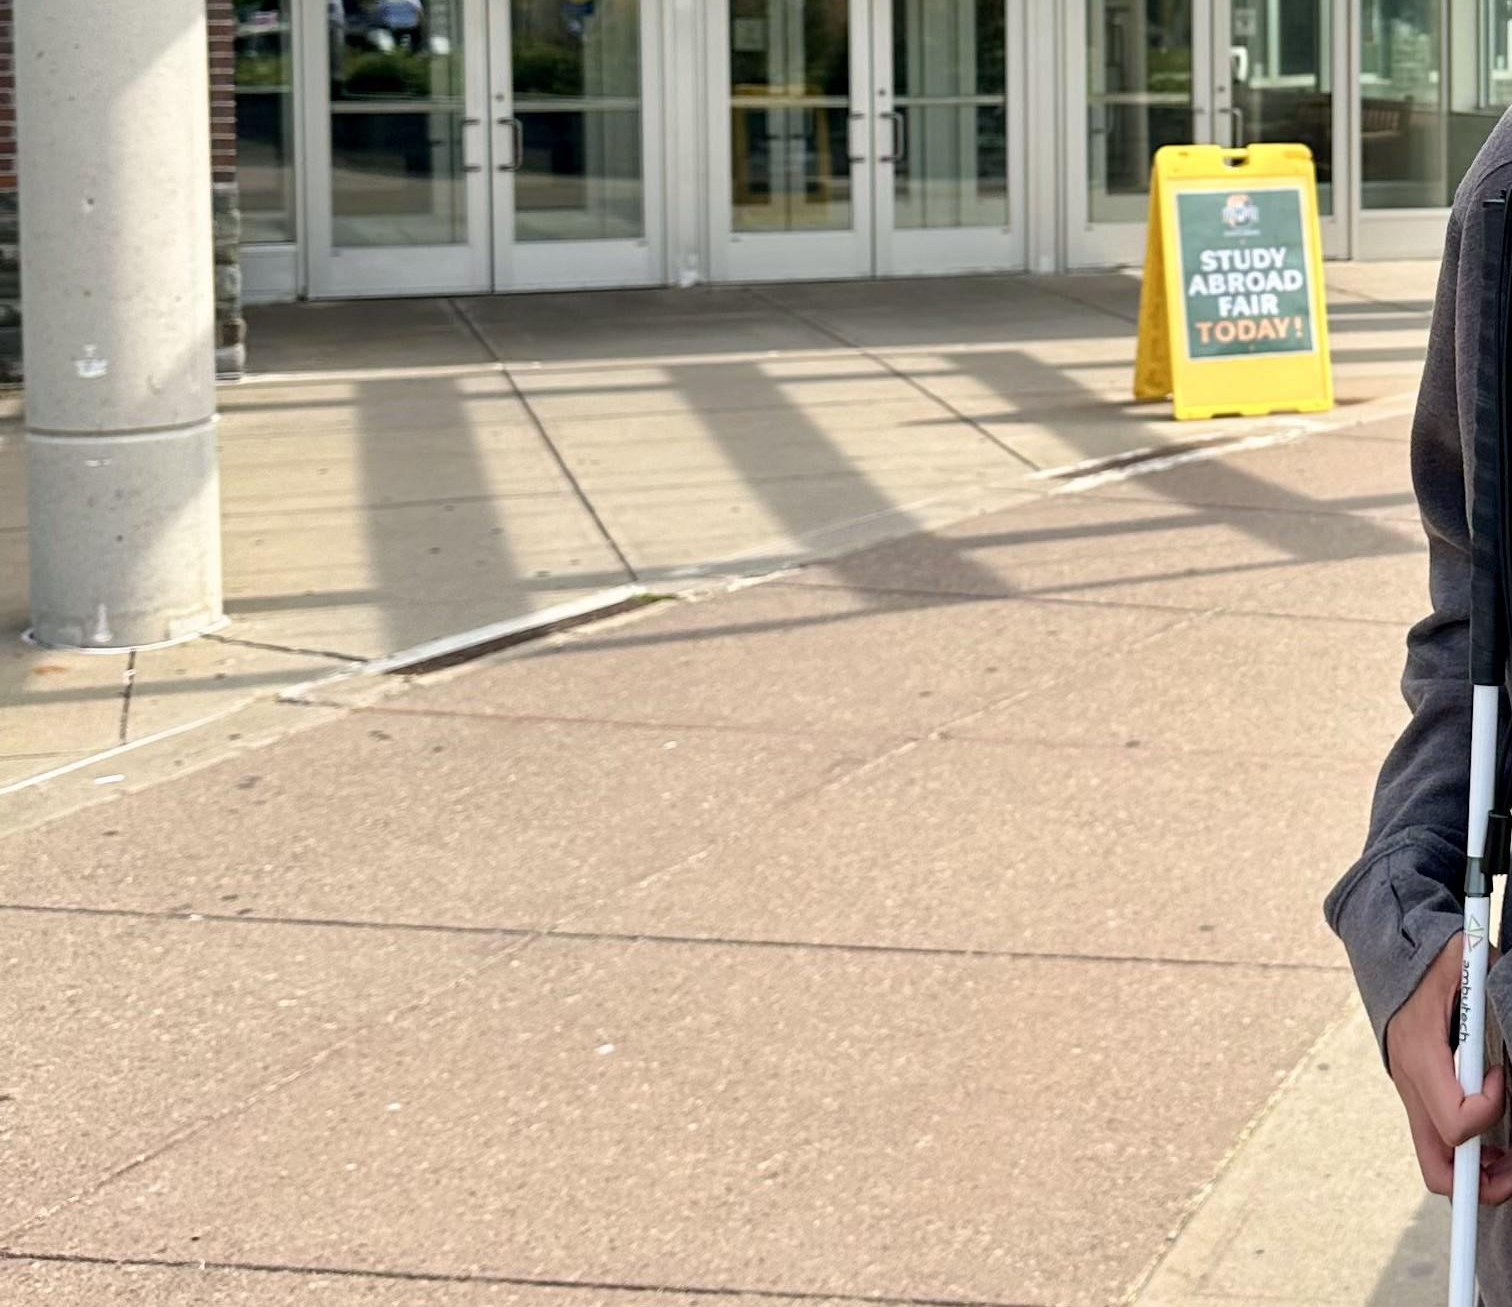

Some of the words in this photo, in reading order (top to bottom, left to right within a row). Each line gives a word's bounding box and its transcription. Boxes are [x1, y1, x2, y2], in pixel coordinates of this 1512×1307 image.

[1199, 247, 1287, 272] STUDY
[1188, 269, 1303, 296] ABROAD
[1218, 293, 1279, 318] FAIR
[1195, 317, 1303, 344] TODAY!
[1459, 959, 1472, 1042] ambutech
